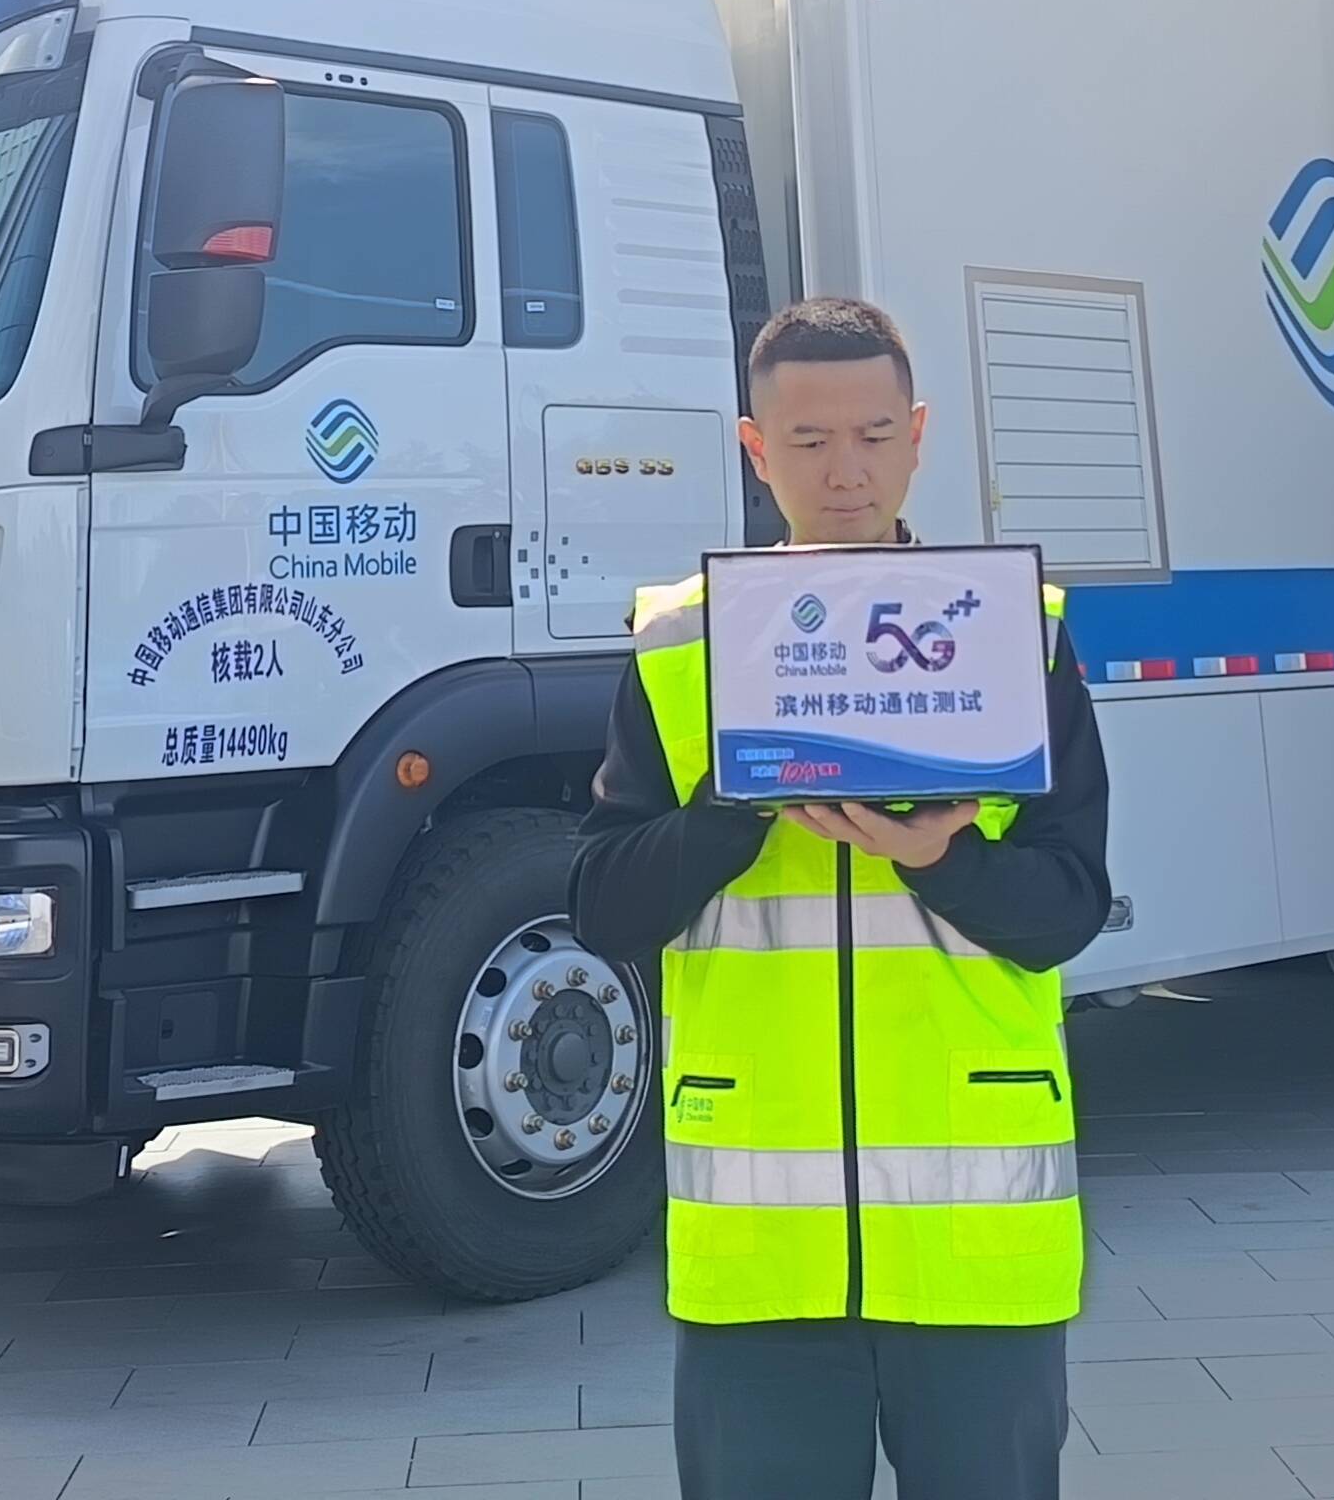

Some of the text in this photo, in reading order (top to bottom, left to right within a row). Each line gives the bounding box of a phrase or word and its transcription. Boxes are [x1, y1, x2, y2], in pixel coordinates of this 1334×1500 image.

[269, 501, 417, 547] 中国移动
[269, 549, 418, 580] China Mobile
[126, 582, 364, 687] 中国移动通信集团有限公司山东分公司
[774, 641, 847, 663] 中国移动
[211, 639, 284, 684] 核载2人
[775, 663, 848, 678] China Mobile
[774, 690, 983, 718] 滨州移动通信测试
[161, 723, 289, 767] 总质量14490kg
